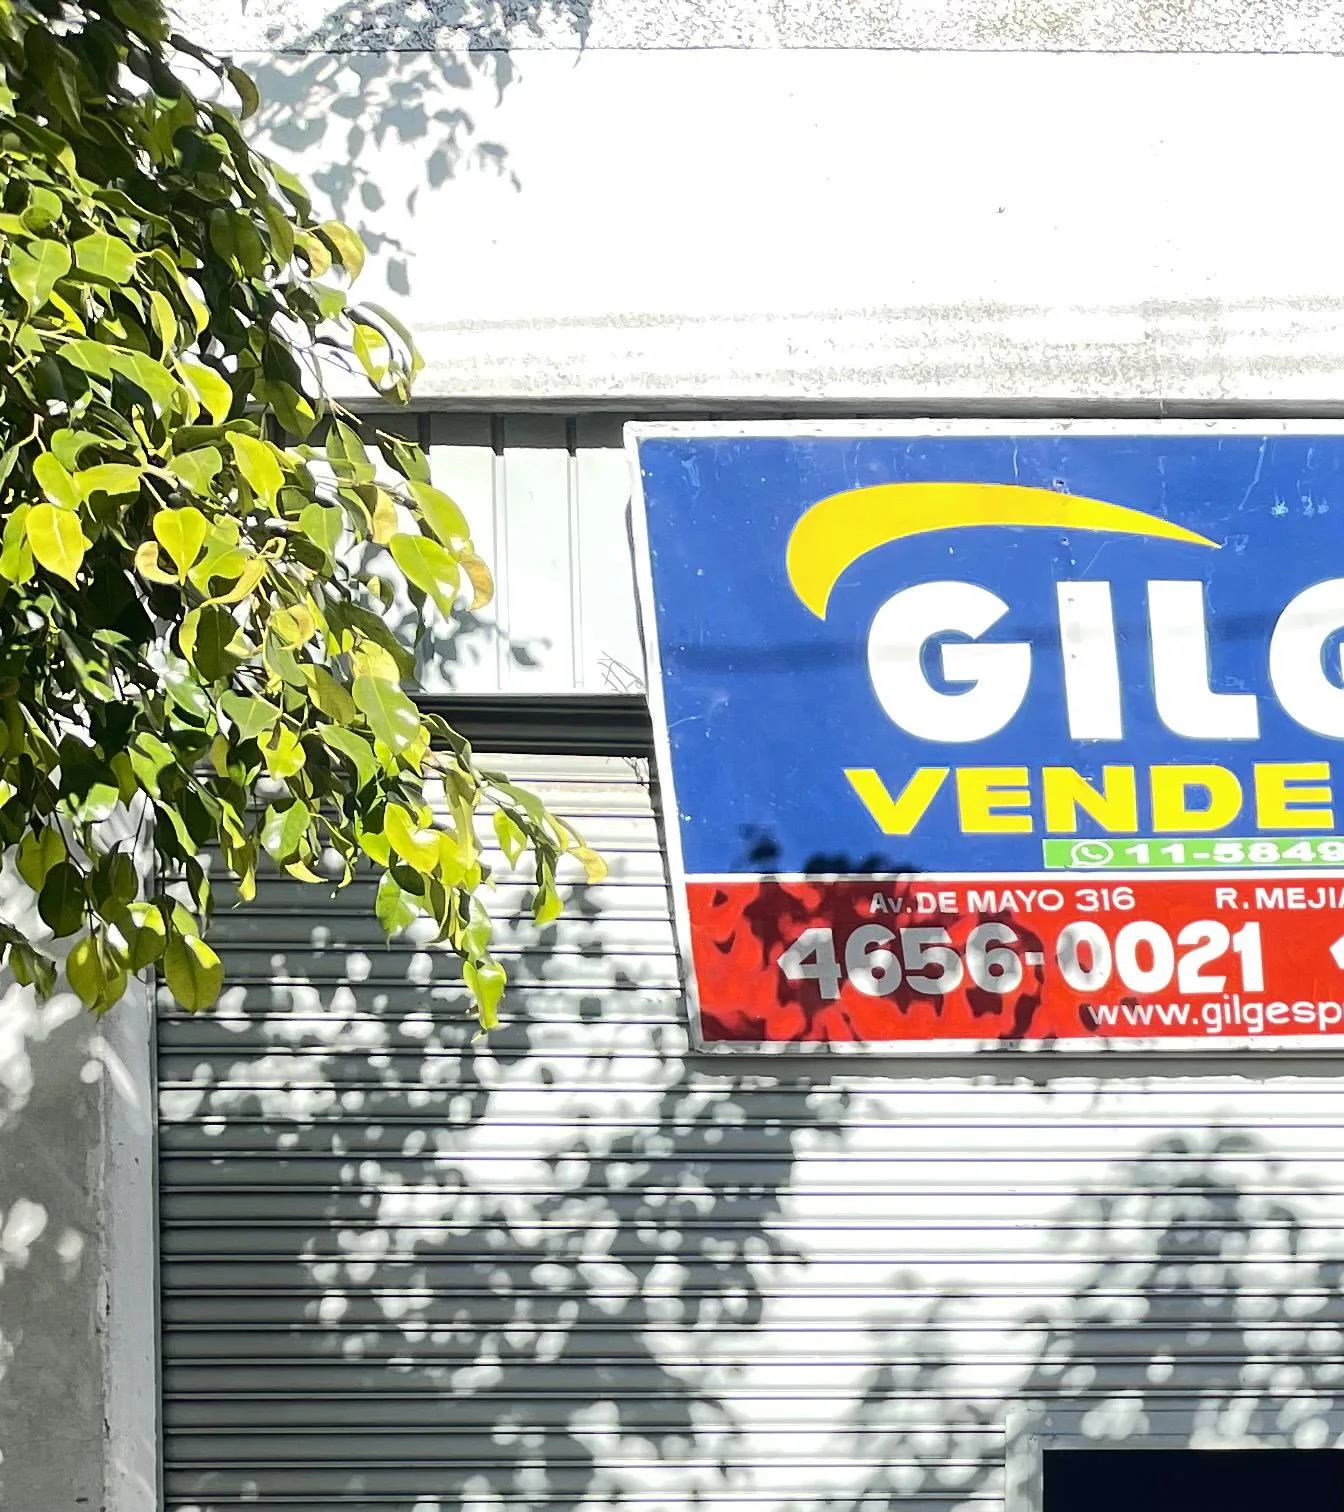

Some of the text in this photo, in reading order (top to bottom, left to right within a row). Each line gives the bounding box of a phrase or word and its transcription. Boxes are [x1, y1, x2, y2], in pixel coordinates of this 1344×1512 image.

[844, 761, 1335, 836] VENDE
[966, 889, 1064, 913] MAYO
[1075, 886, 1136, 912] 316
[776, 921, 1265, 1000] 4656-0021
